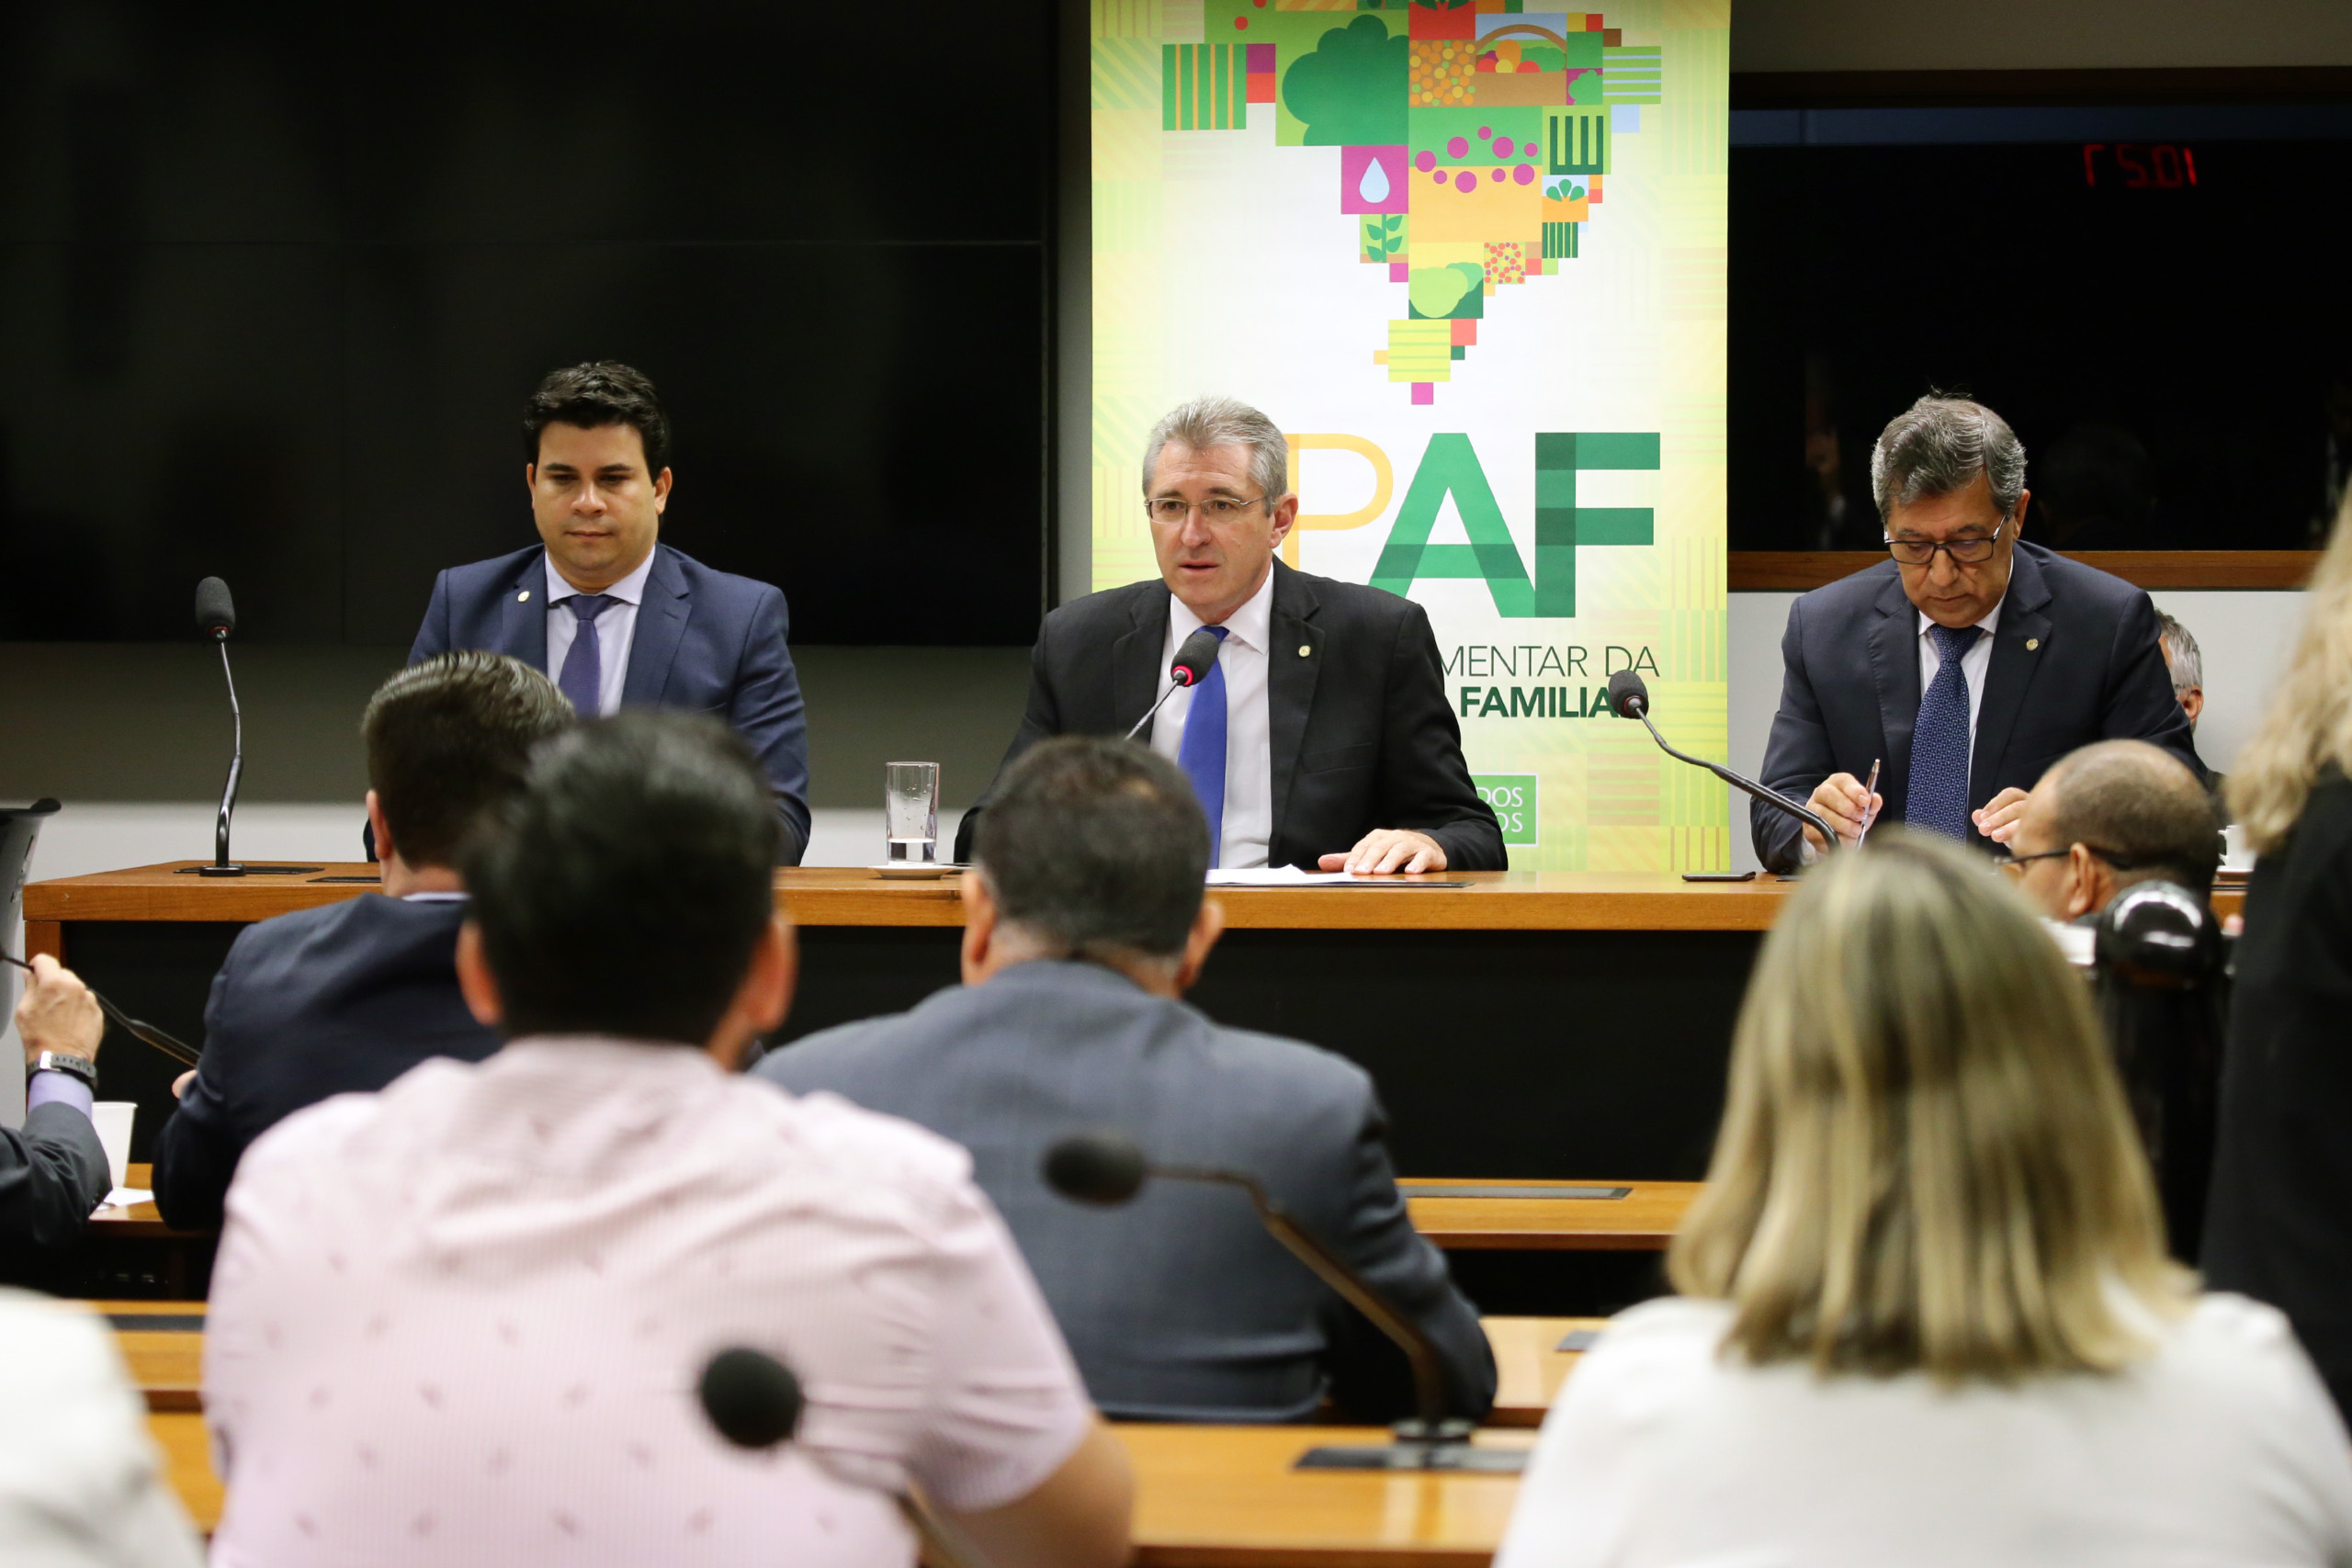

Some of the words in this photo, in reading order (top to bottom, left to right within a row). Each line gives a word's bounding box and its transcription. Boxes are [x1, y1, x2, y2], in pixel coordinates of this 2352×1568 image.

[1283, 432, 1660, 618] PAF
[1440, 645, 1588, 677] MENTAR
[1605, 645, 1660, 677] DA
[1460, 686, 1620, 718] FAMILIA
